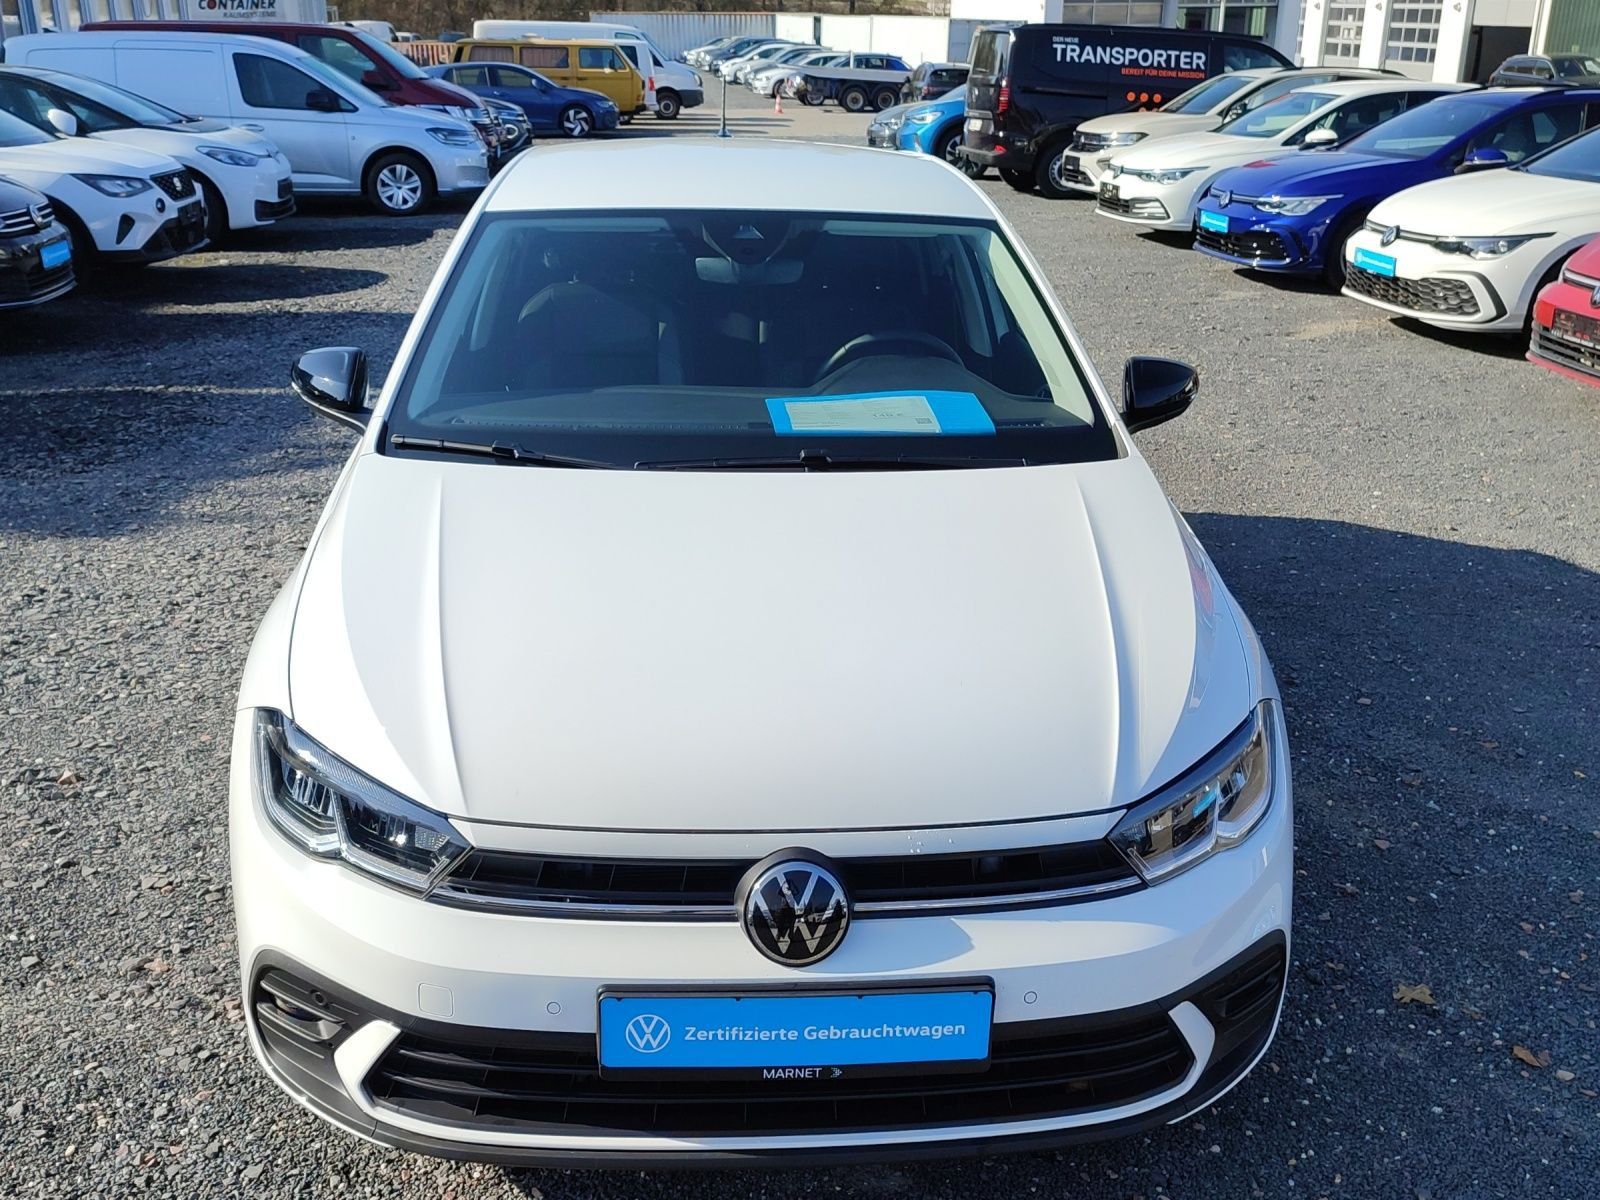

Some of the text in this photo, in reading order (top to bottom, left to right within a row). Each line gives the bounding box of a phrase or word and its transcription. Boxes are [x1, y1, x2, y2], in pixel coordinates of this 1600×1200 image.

[198, 0, 275, 10] CONTAINER
[1052, 43, 1207, 70] TRANSPORTER
[1121, 67, 1144, 75] BEREIT
[1177, 71, 1205, 79] MISSION
[684, 1026, 799, 1041] Zertifizierte
[803, 1023, 966, 1041] Gebrauchtwagen
[762, 1067, 822, 1079] MARNET
